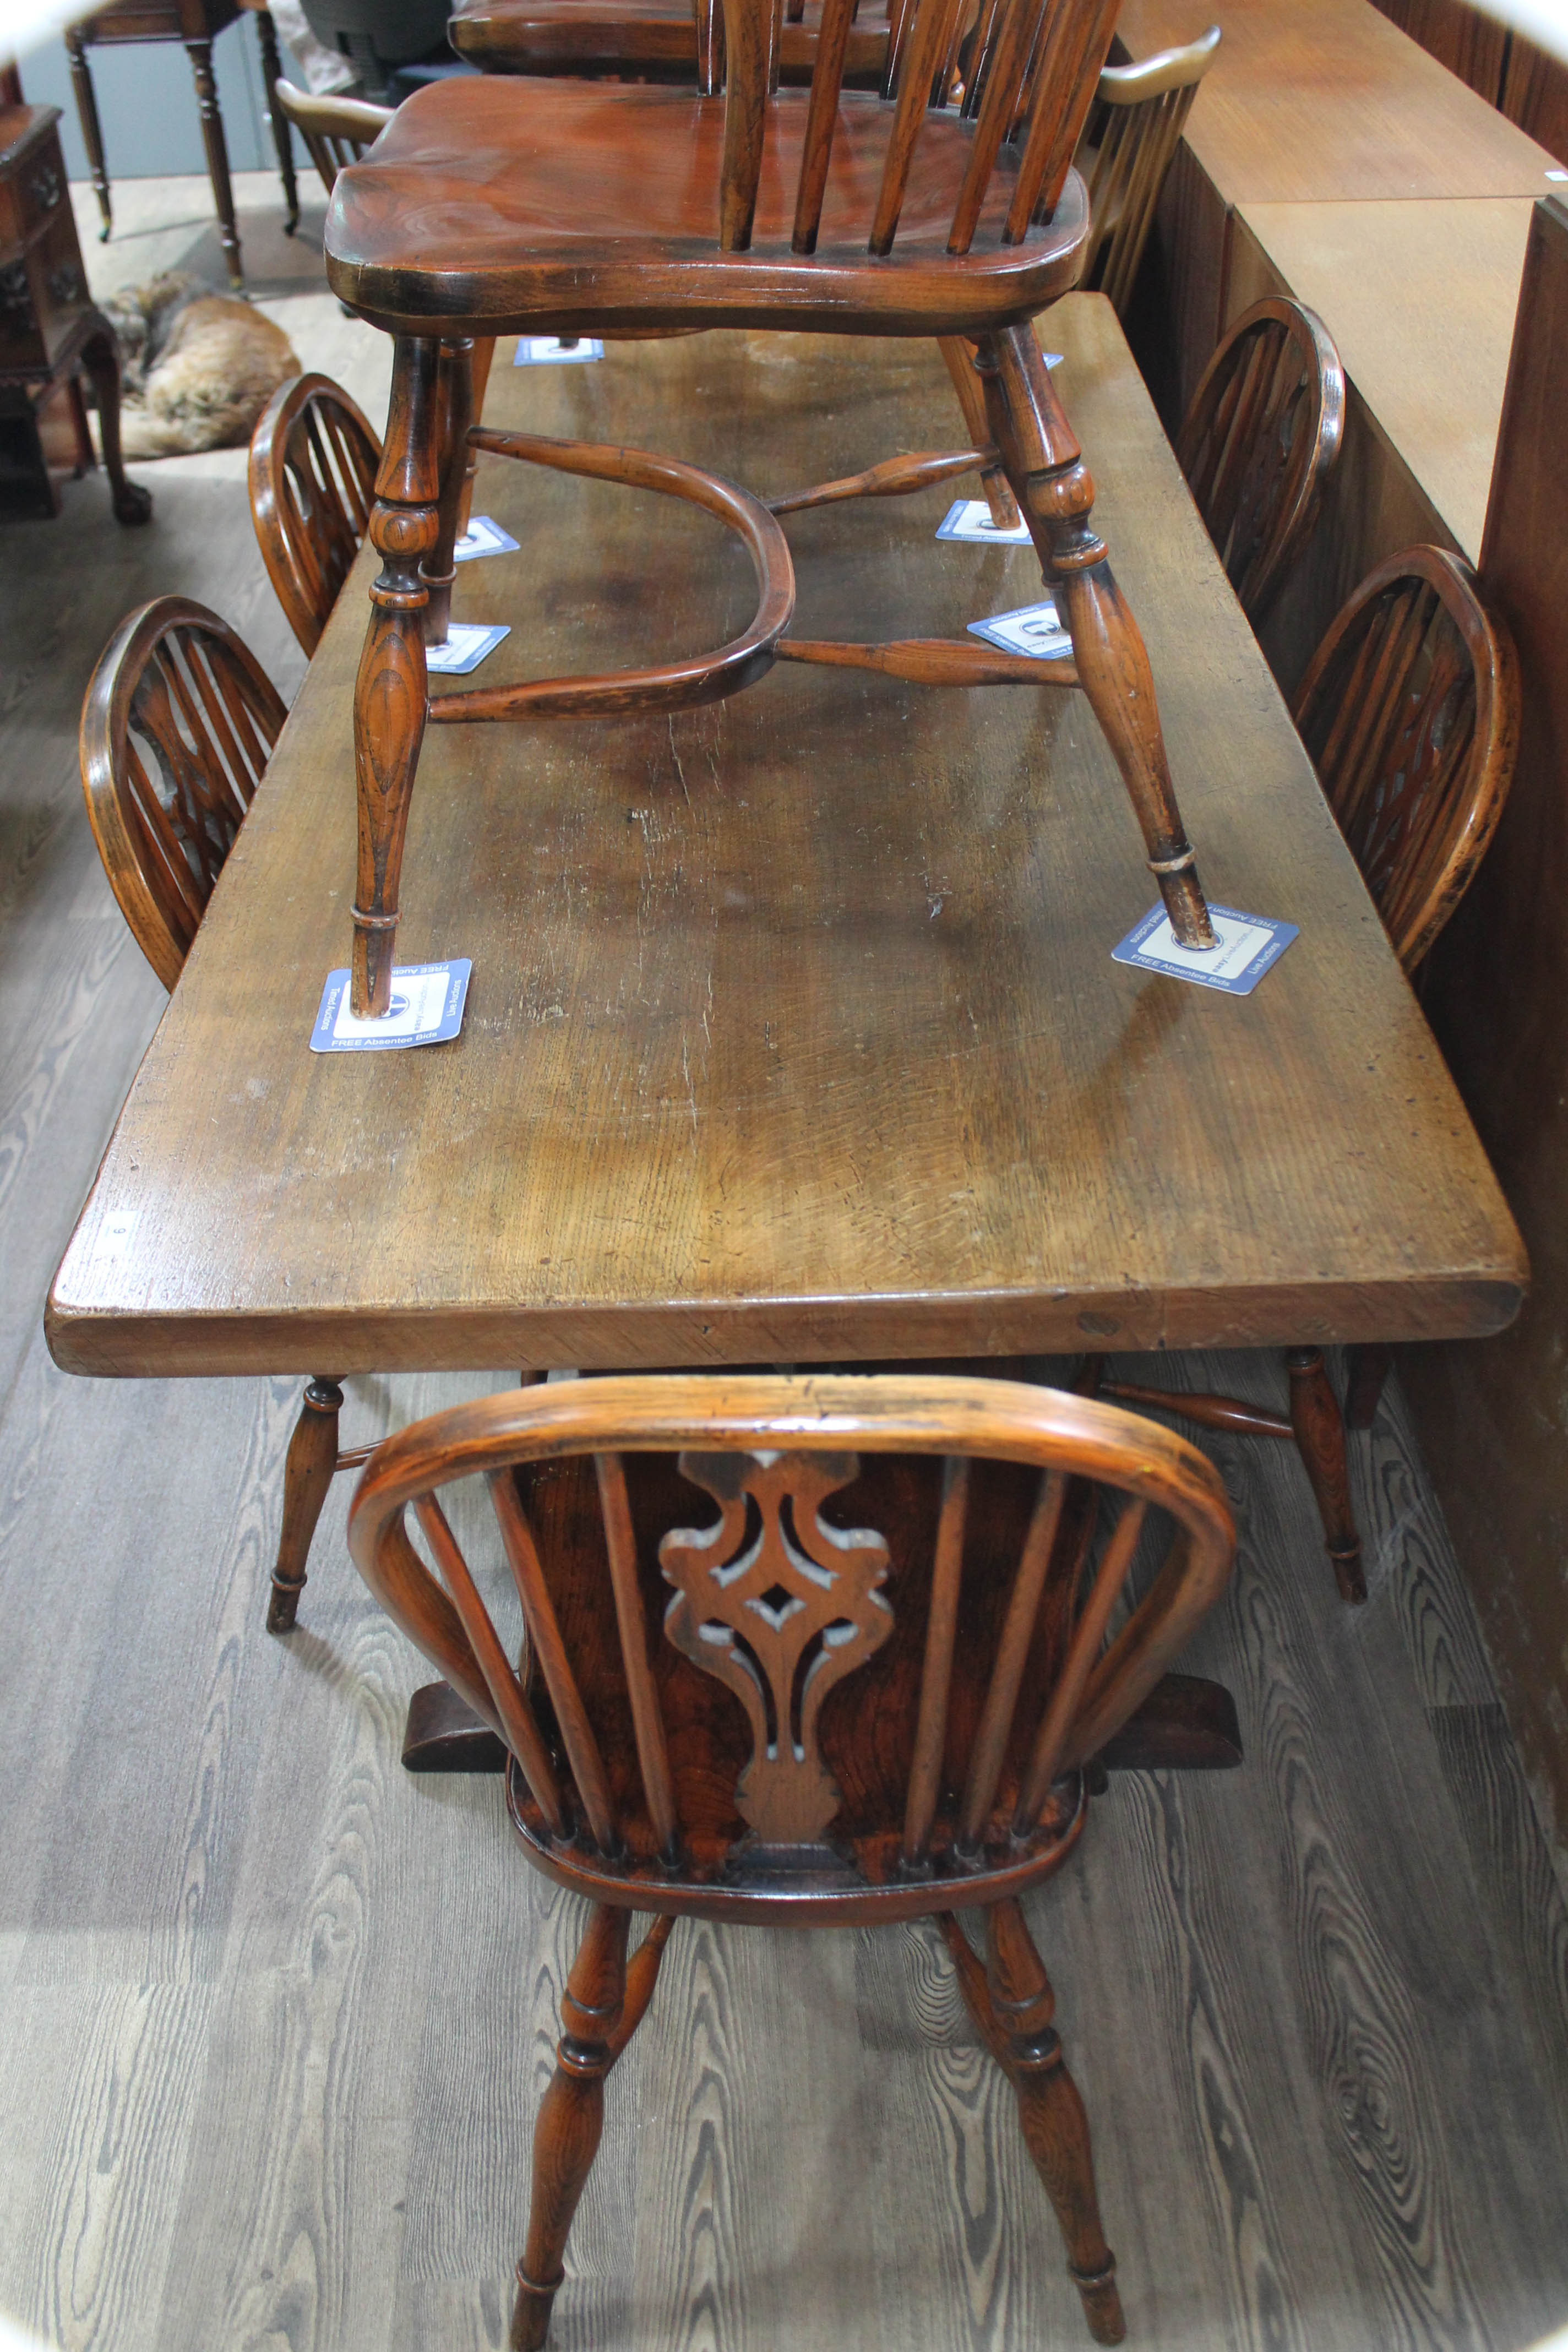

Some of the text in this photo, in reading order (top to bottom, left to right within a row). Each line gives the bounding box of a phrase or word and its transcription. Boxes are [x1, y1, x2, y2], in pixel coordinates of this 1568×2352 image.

[1213, 908, 1278, 929] FREE Auction
[1130, 922, 1155, 943] Auctions
[1247, 942, 1281, 974] Live Auctions
[420, 964, 449, 974] FREE
[1131, 954, 1231, 987] FREE Absentee Bids
[320, 987, 340, 1031] Timed Auctions
[364, 1036, 412, 1046] Absentee
[415, 1031, 438, 1041] Bids
